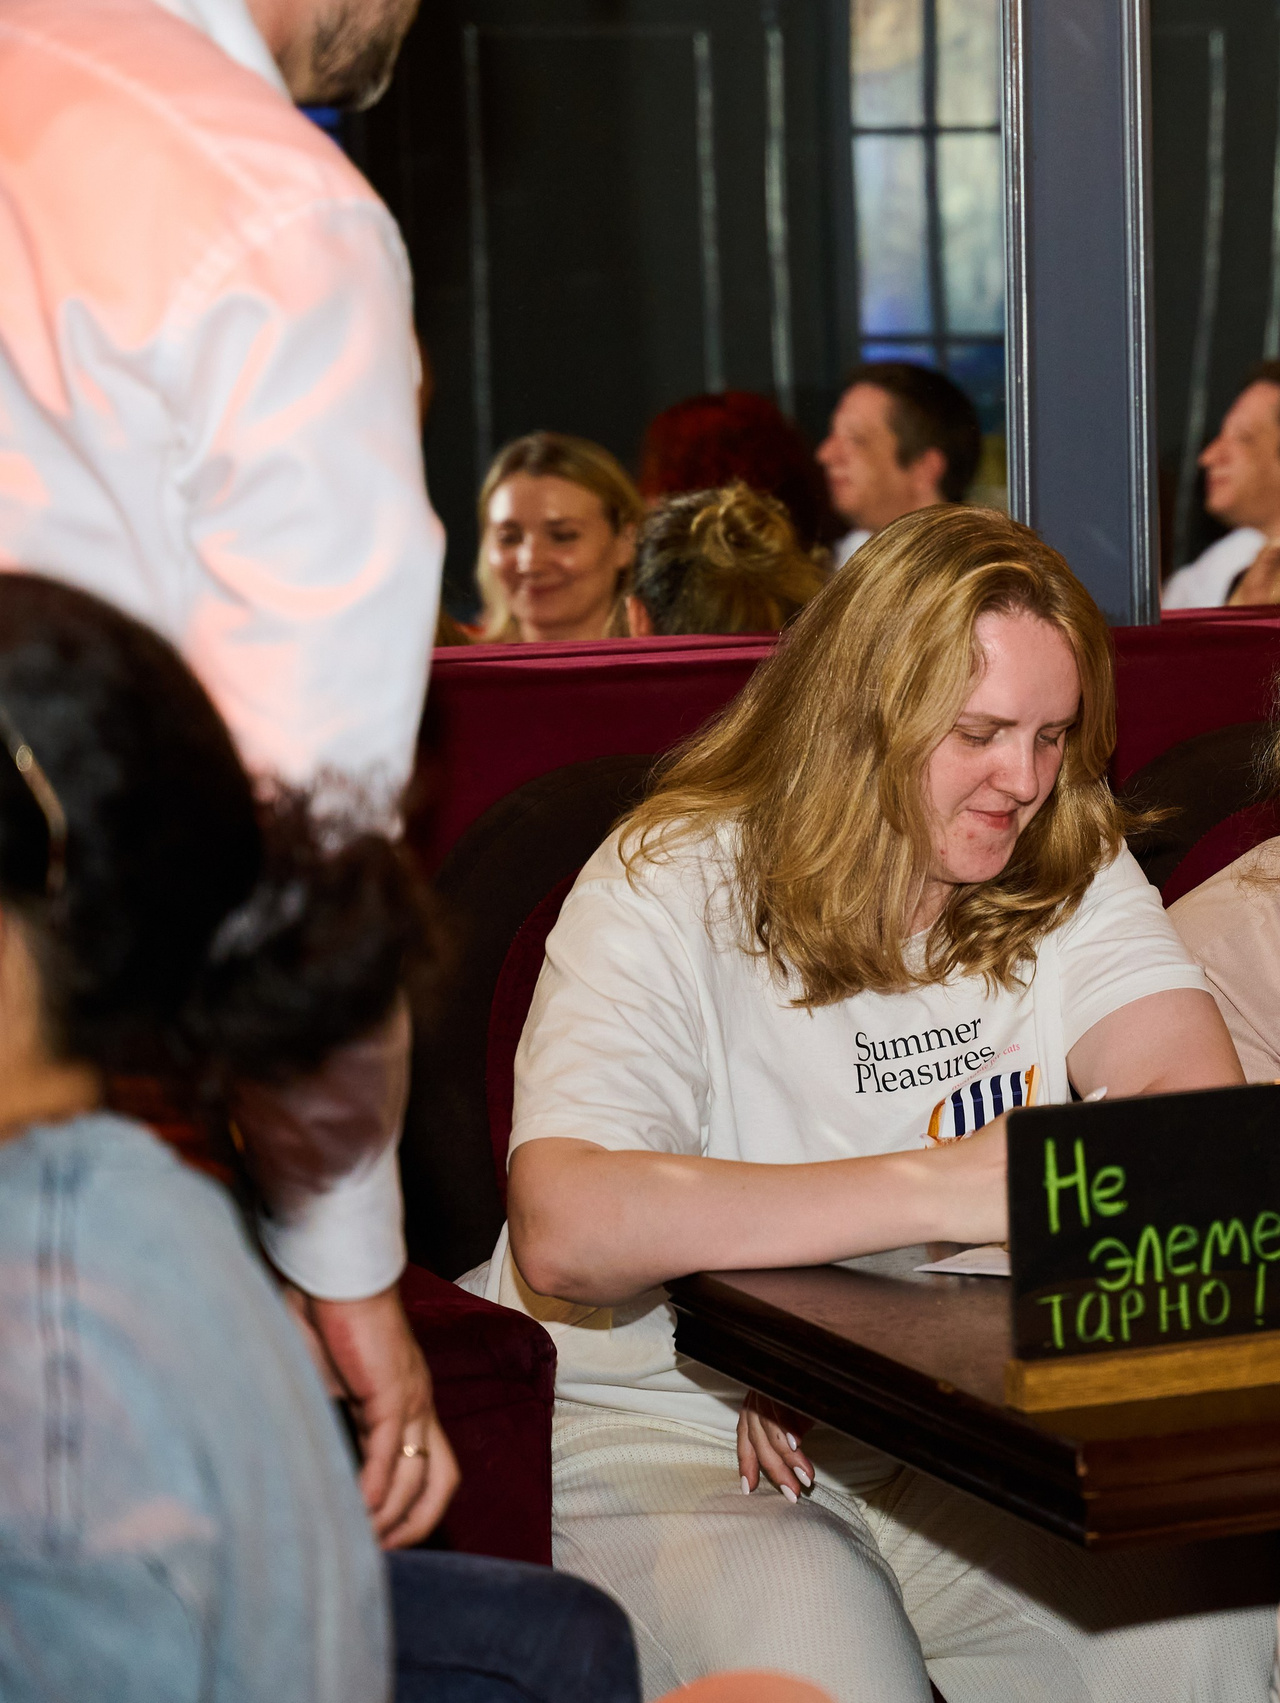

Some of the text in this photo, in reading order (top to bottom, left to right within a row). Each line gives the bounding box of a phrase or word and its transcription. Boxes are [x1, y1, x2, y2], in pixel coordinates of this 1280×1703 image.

[855, 1018, 982, 1062] Summer
[1002, 1043, 1021, 1056] cats
[853, 1045, 995, 1094] Pleasures
[1043, 1137, 1128, 1235] Не
